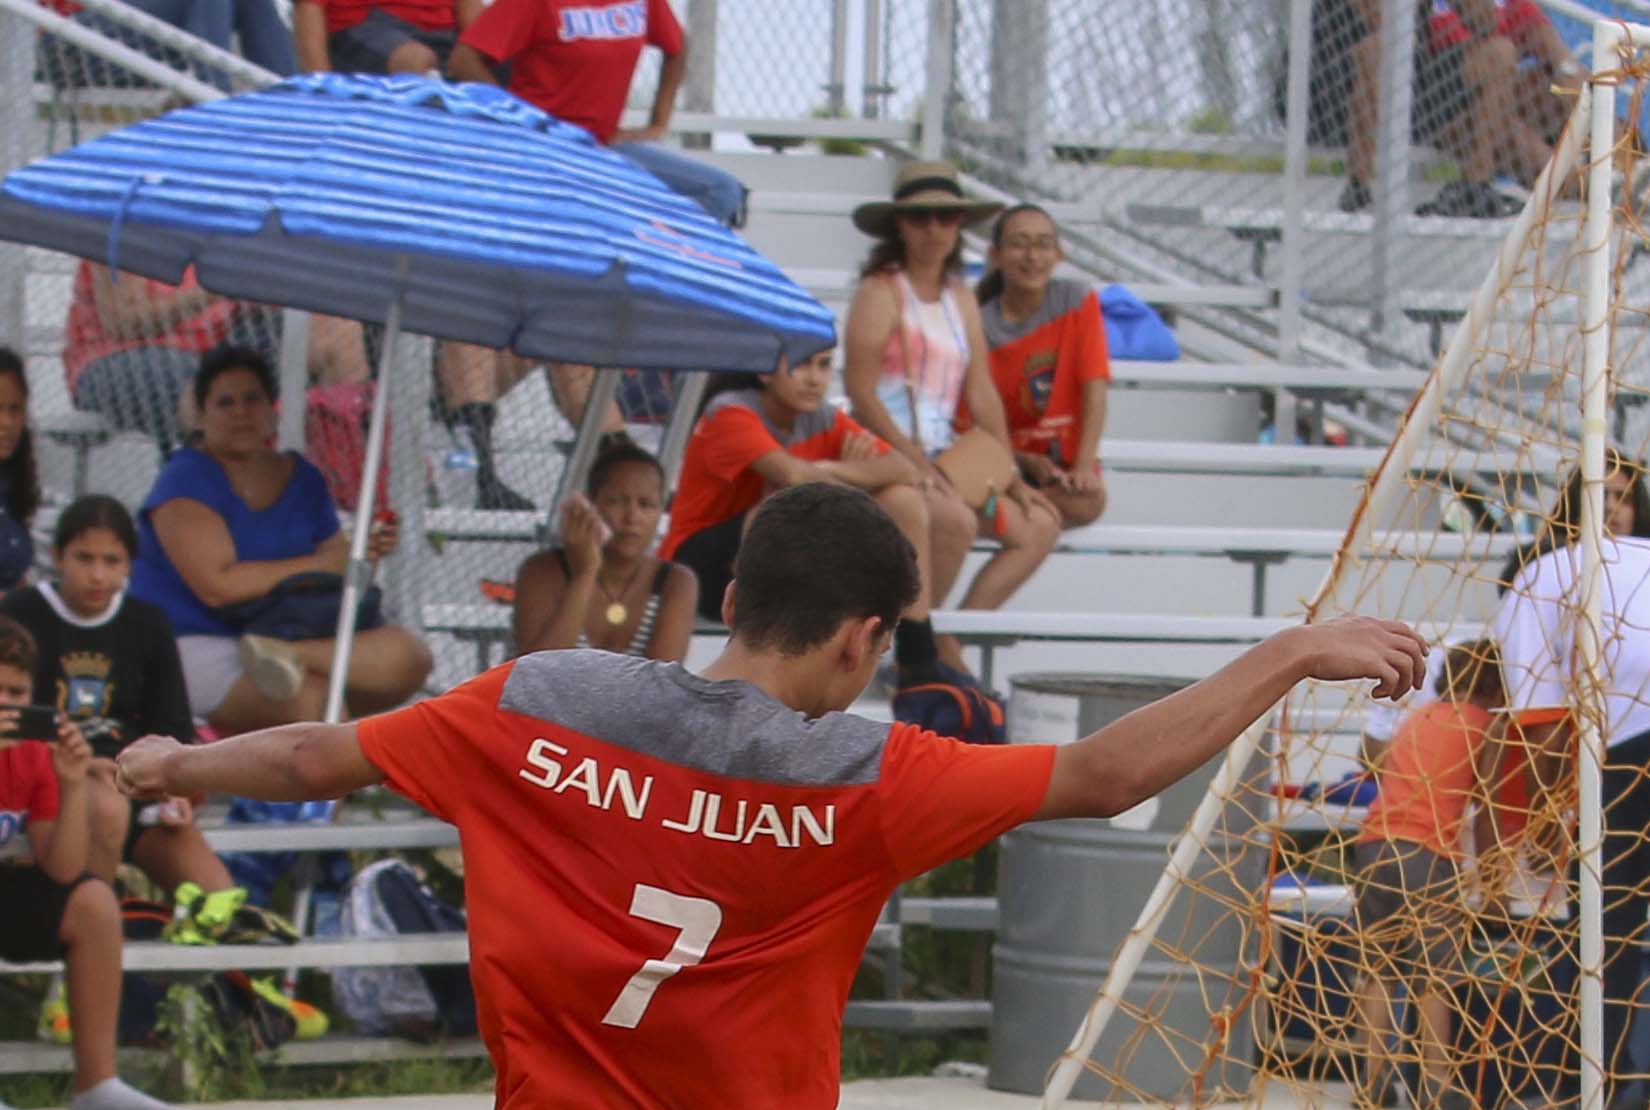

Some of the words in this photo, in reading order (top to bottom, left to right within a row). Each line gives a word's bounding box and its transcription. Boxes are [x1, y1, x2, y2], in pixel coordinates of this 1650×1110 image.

[519, 738, 654, 820] SAN
[661, 789, 836, 848] JUAN
[601, 883, 723, 1029] 7
